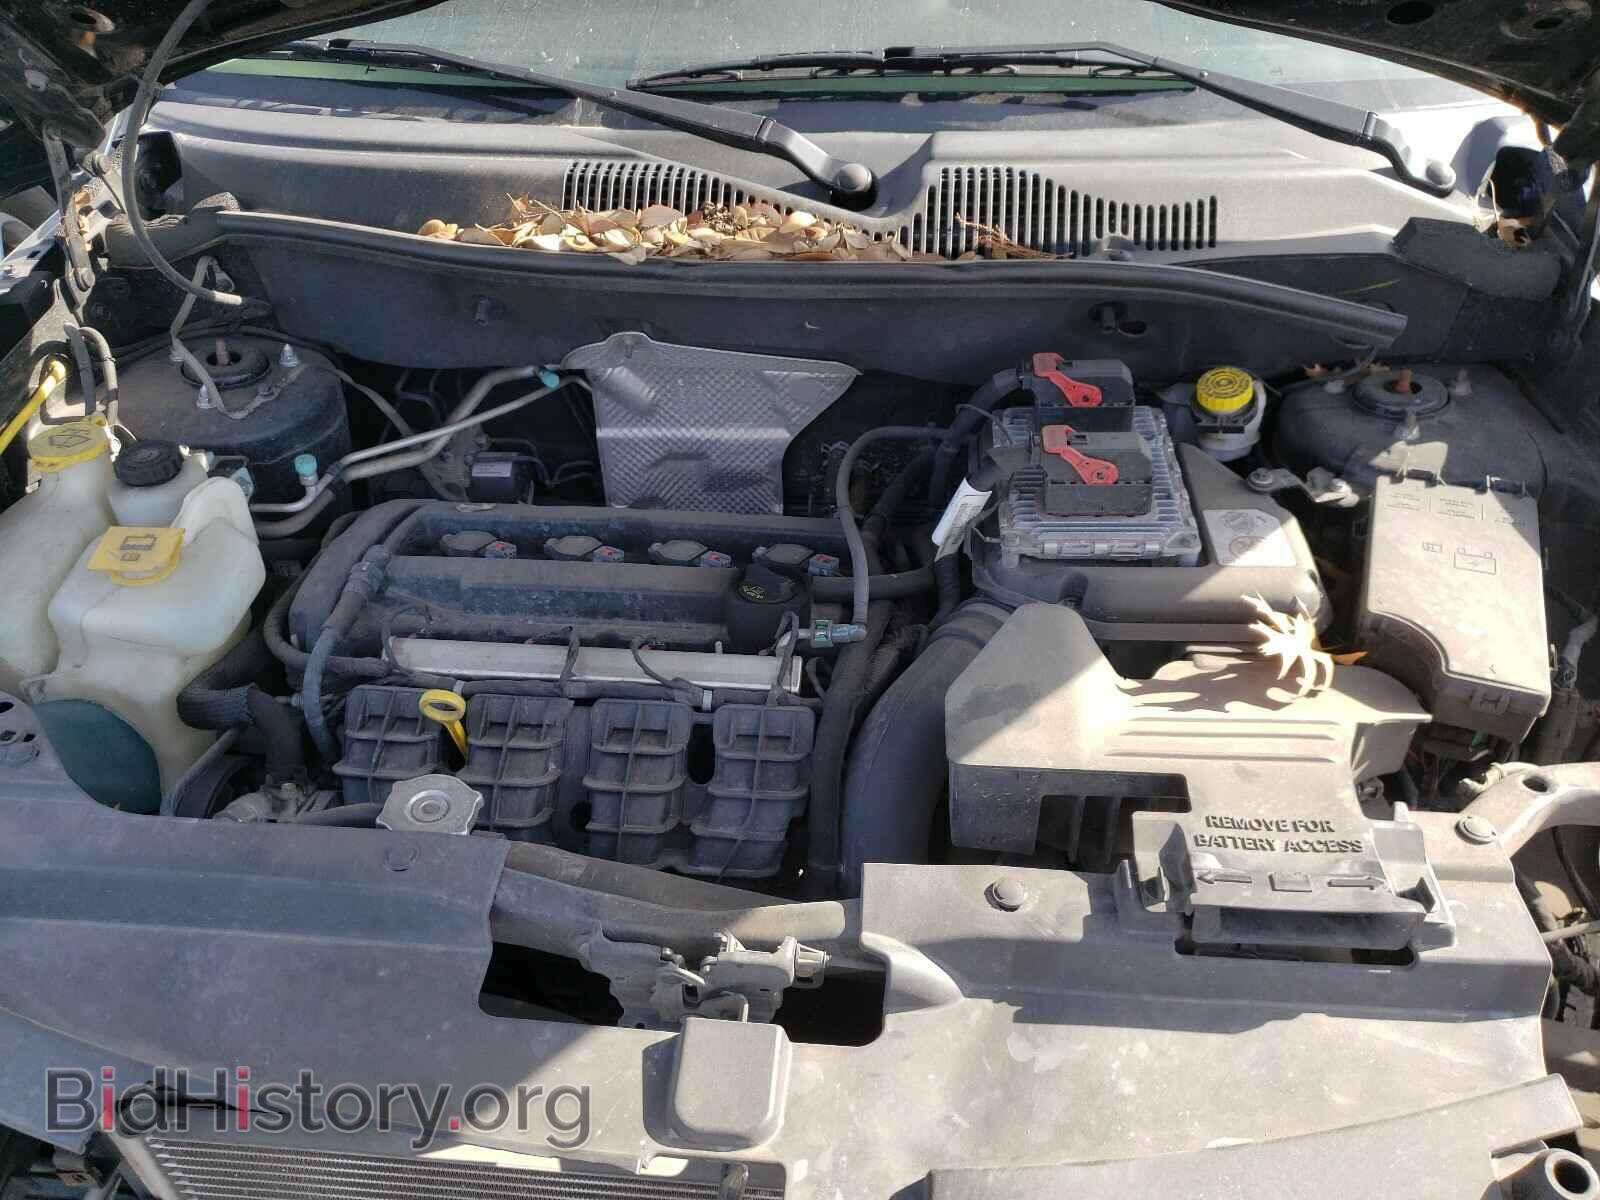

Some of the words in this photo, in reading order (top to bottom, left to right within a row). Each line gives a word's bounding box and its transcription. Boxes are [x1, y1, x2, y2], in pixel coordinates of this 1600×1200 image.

[1205, 816, 1289, 832] REMOVE
[1291, 819, 1335, 833] FOR
[1193, 834, 1276, 851] BATTERY
[1284, 839, 1363, 853] ACCESS
